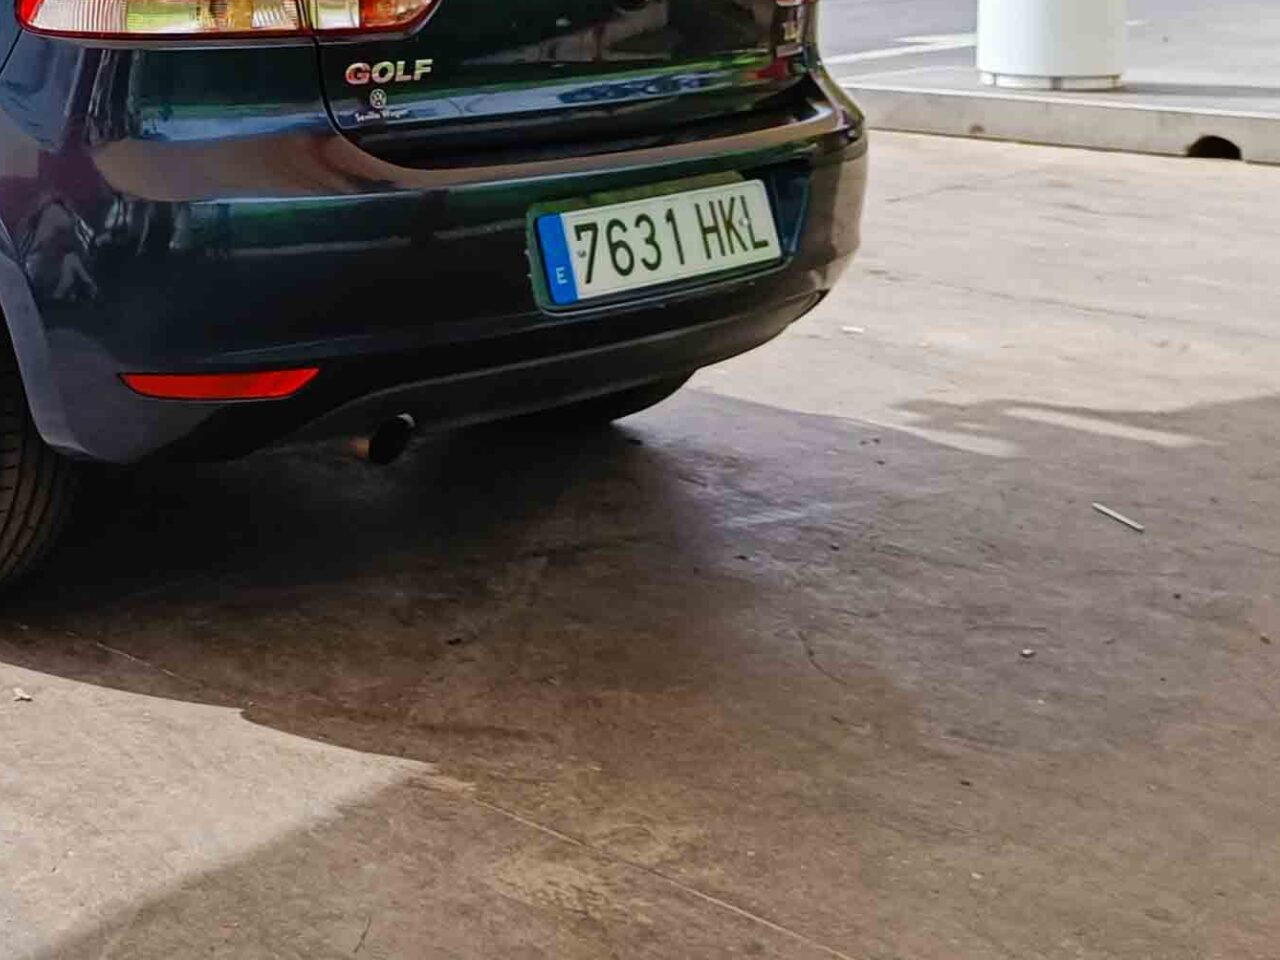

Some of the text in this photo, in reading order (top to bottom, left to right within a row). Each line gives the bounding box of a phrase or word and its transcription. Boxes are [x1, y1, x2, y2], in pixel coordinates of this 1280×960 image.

[345, 59, 433, 85] GOLF
[555, 194, 770, 286] E 7631 HKL
